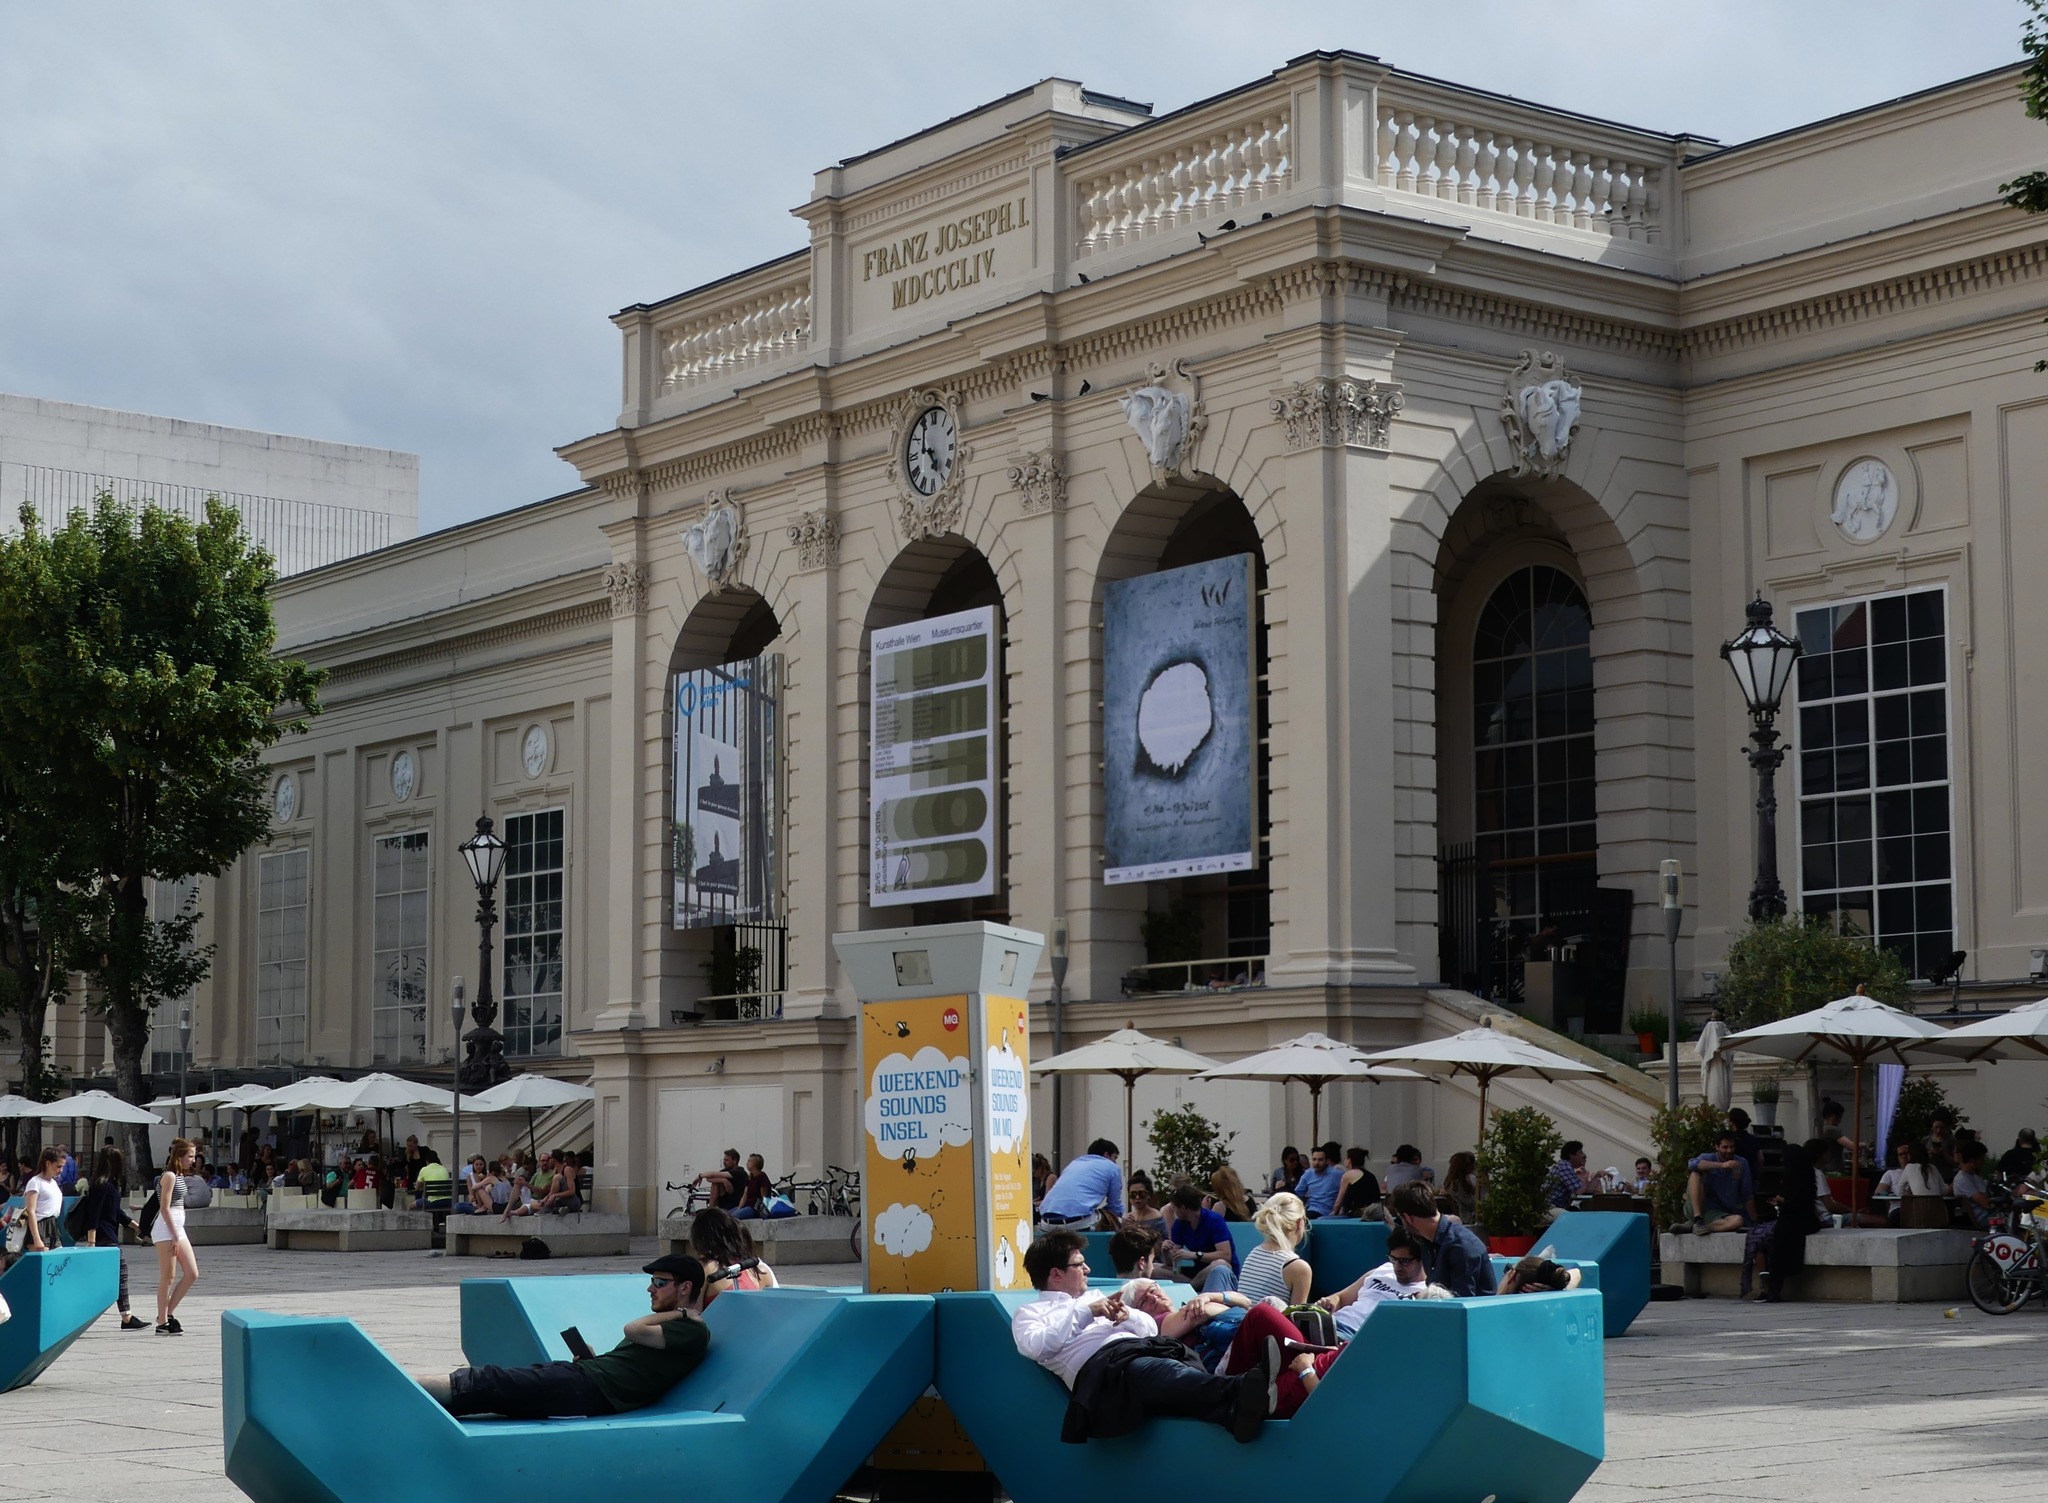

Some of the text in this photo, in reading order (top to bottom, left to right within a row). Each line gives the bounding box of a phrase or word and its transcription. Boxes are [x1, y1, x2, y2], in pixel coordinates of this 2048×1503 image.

[863, 231, 929, 282] FRANZ
[892, 247, 996, 310] MDCCCLIV.
[875, 621, 983, 651] Kunsthalle Wien Museumsquartier
[944, 1015, 958, 1025] MQ
[879, 1069, 959, 1092] WEEKEND
[992, 1069, 1022, 1089] WEEKEND
[880, 1095, 946, 1117] SOUNDS
[992, 1093, 1018, 1112] SOUNDS
[880, 1121, 928, 1141] INSEL
